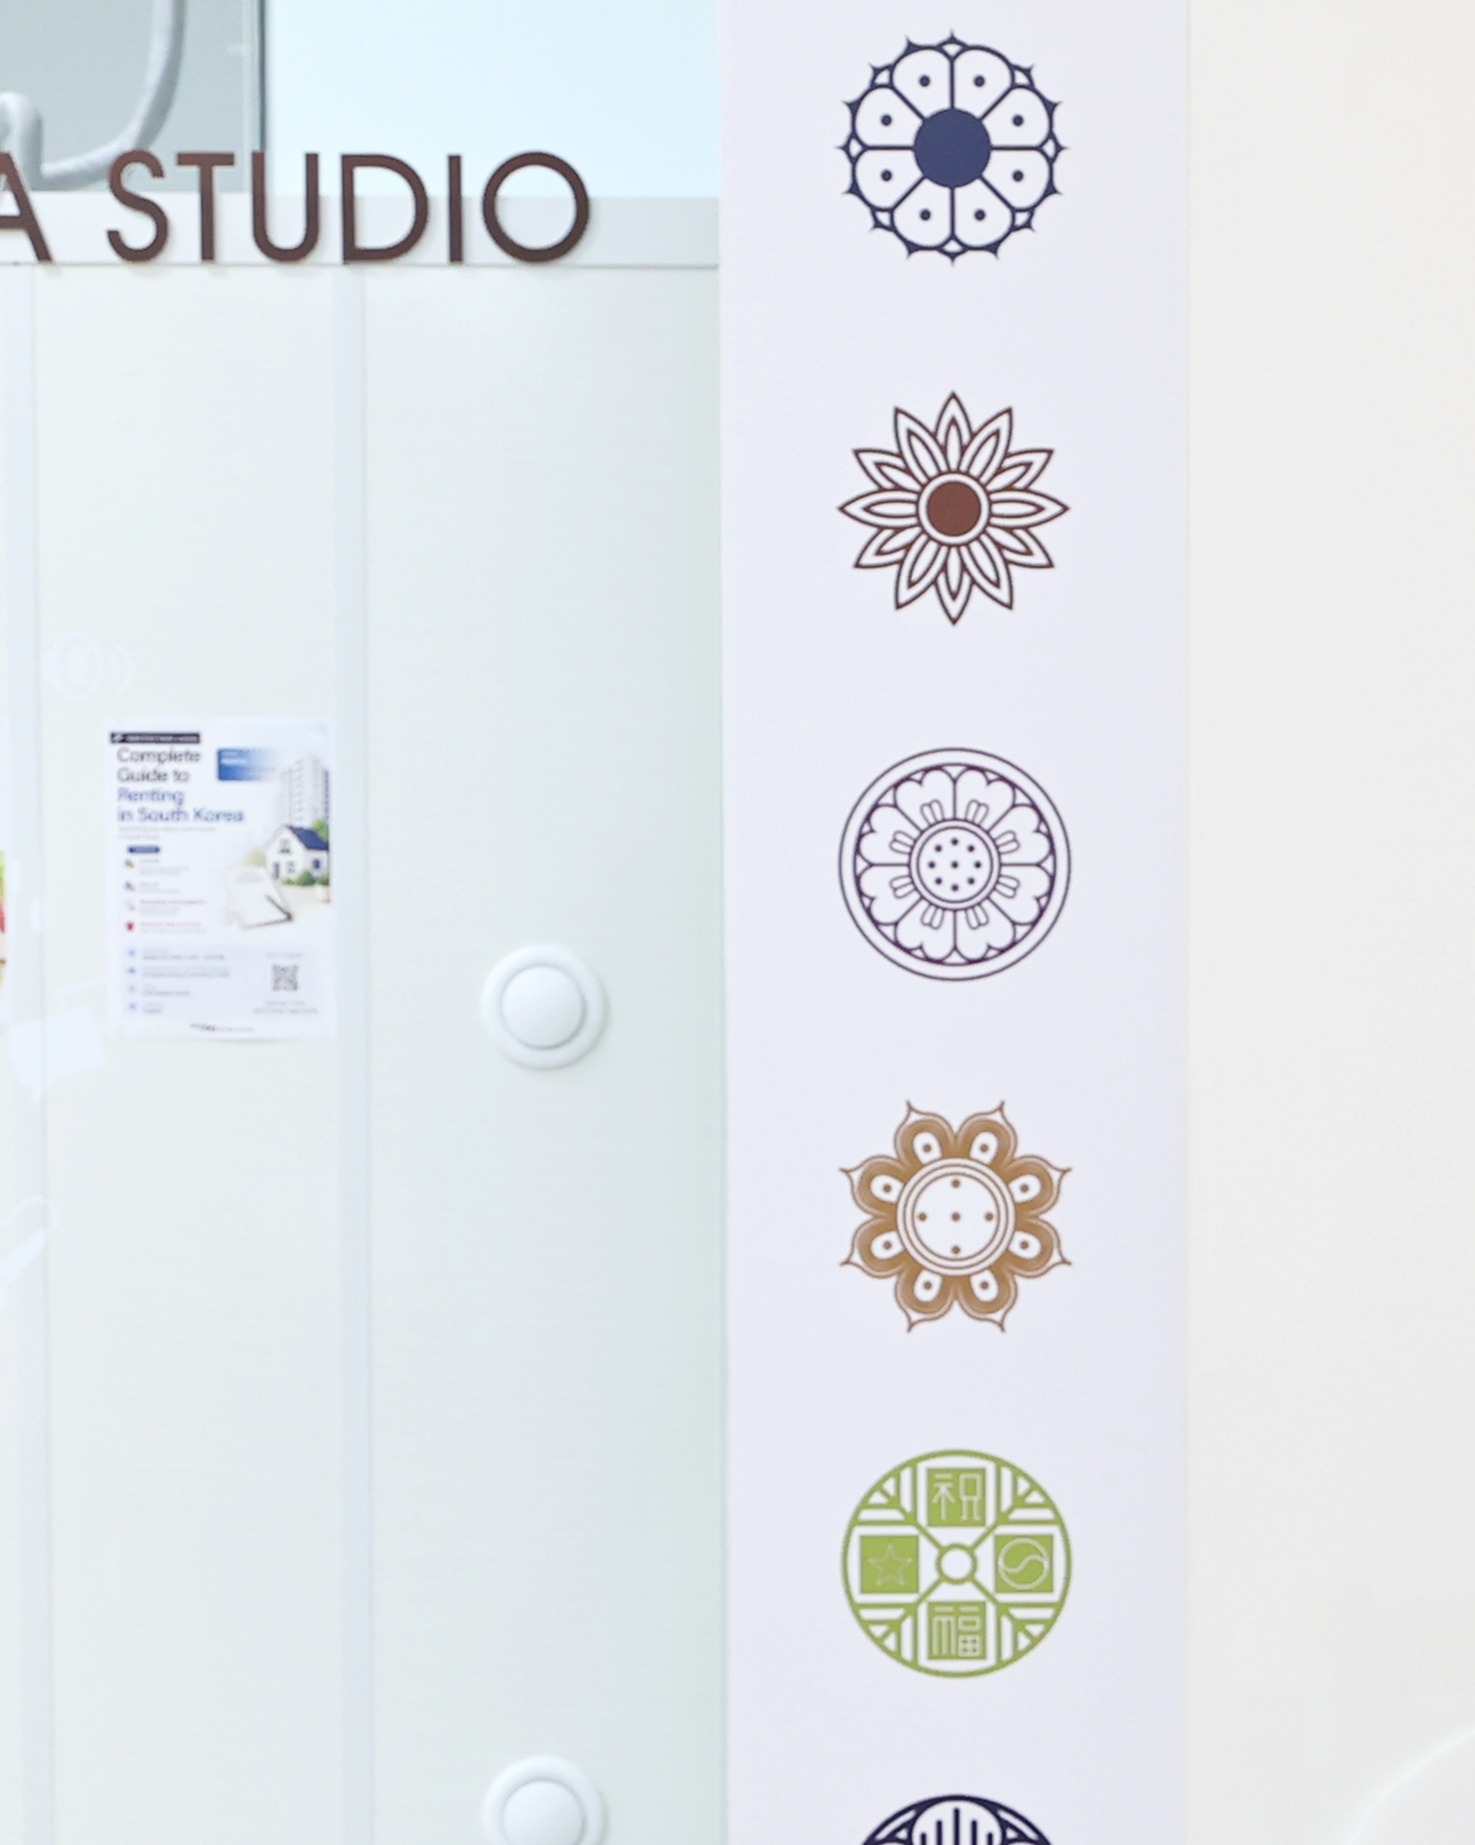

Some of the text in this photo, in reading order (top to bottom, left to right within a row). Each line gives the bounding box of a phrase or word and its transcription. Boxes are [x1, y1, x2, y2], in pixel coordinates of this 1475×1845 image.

[105, 149, 591, 264] STUDIO
[116, 746, 202, 765] Complete
[116, 766, 191, 782] Guide to
[117, 786, 185, 807] Renting
[117, 806, 244, 822] in South Korea
